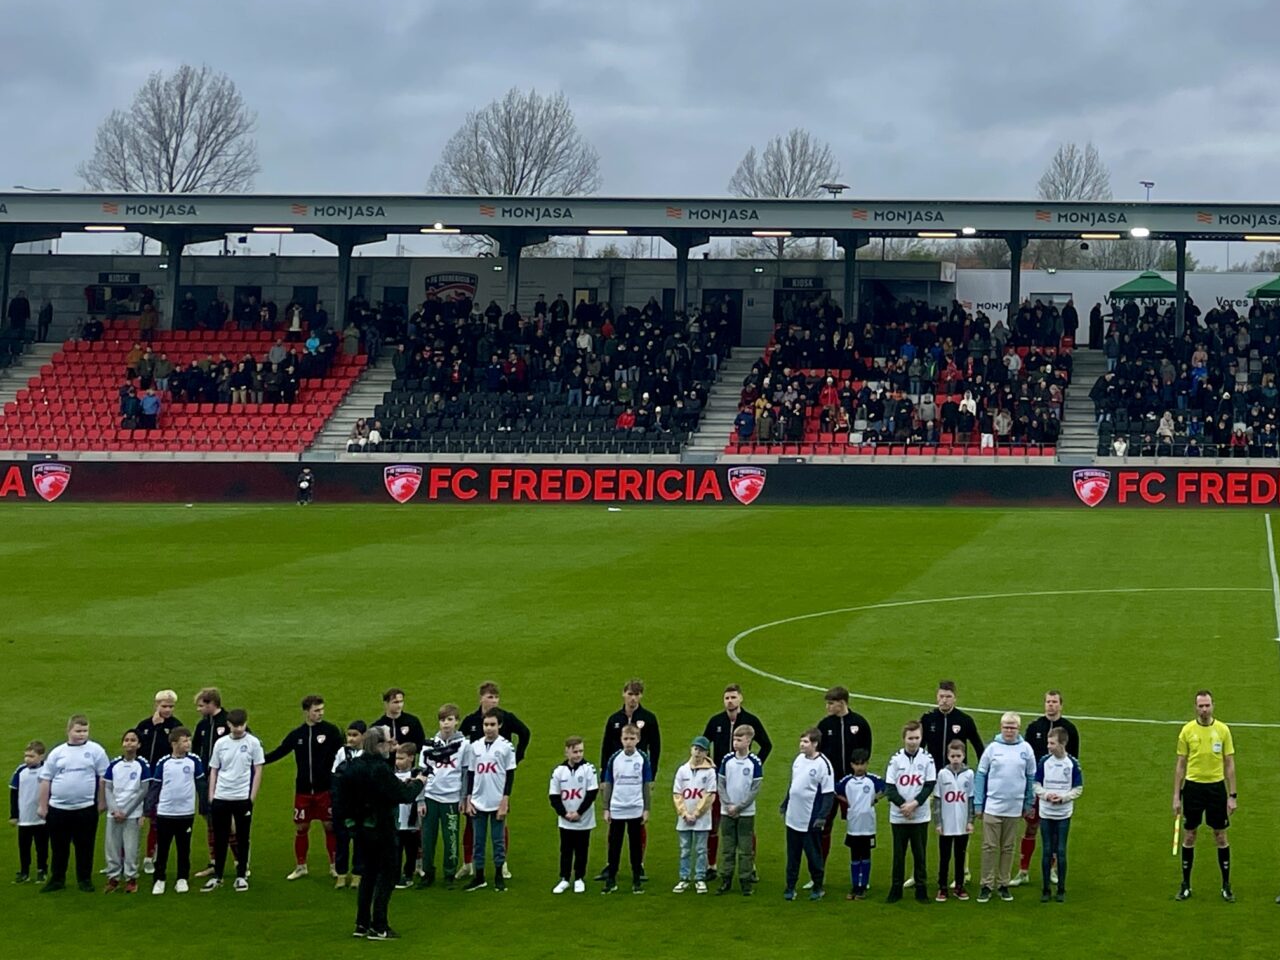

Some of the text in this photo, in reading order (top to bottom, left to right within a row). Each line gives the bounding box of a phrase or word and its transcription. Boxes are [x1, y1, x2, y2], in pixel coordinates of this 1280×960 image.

[125, 204, 198, 218] MONJASA
[313, 205, 387, 219] MONJASA
[501, 206, 574, 220] MONJASA
[688, 208, 760, 222] MONJASA
[874, 210, 945, 224] MONJASA
[1057, 211, 1128, 226] MONJASA
[792, 278, 814, 287] KIOSK
[976, 302, 1010, 312] MONJA
[430, 468, 722, 501] FC FREDERICIA
[1118, 472, 1165, 504] FC
[477, 762, 498, 774] OK
[899, 774, 923, 787] OK
[560, 788, 583, 801] OK
[682, 788, 705, 800] OK
[944, 790, 967, 803] OK
[294, 807, 305, 820] 24
